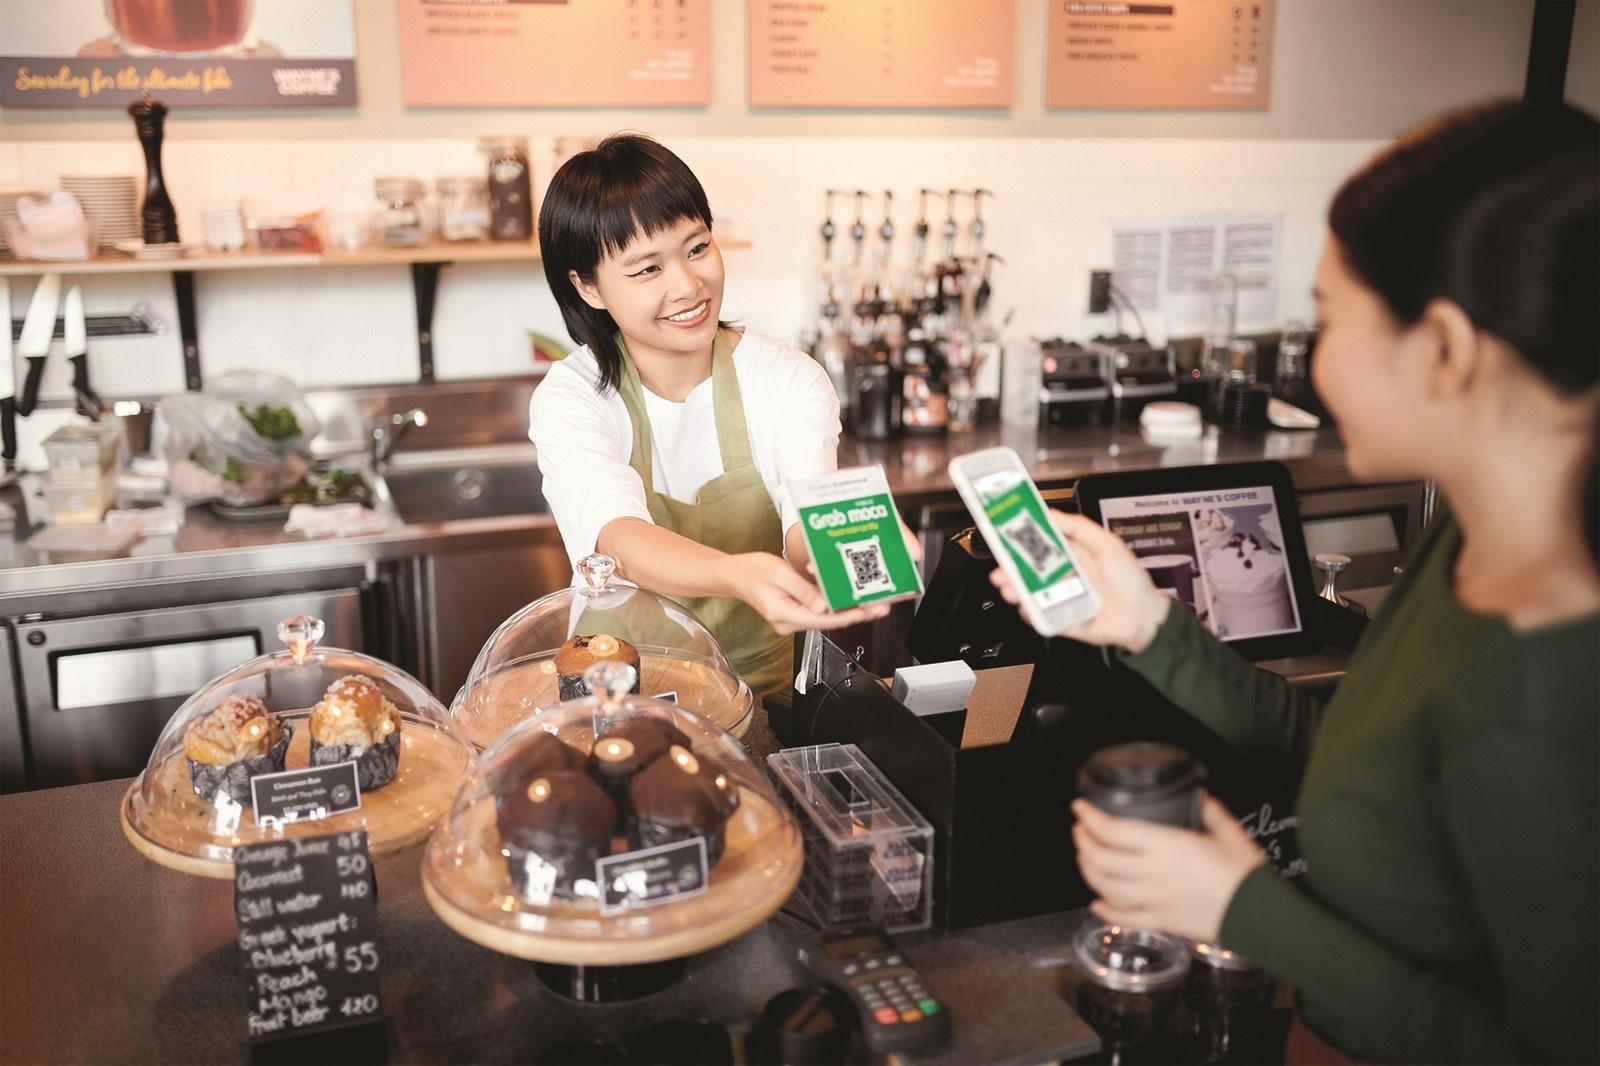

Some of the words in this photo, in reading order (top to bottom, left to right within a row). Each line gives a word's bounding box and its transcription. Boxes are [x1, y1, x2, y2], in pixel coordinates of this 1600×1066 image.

[1224, 491, 1258, 502] COFFEE
[808, 508, 847, 530] Grab
[847, 504, 889, 524] moca
[273, 780, 307, 790] Cinnamon
[307, 777, 322, 785] Bun
[336, 830, 361, 850] 45
[237, 864, 304, 892] Coconut
[336, 854, 367, 877] 50
[341, 880, 369, 898] 40
[344, 941, 379, 973] 55
[257, 965, 318, 995] Peach
[259, 985, 328, 1014] Mango
[248, 1011, 289, 1037] Fruit
[340, 993, 379, 1016] 120
